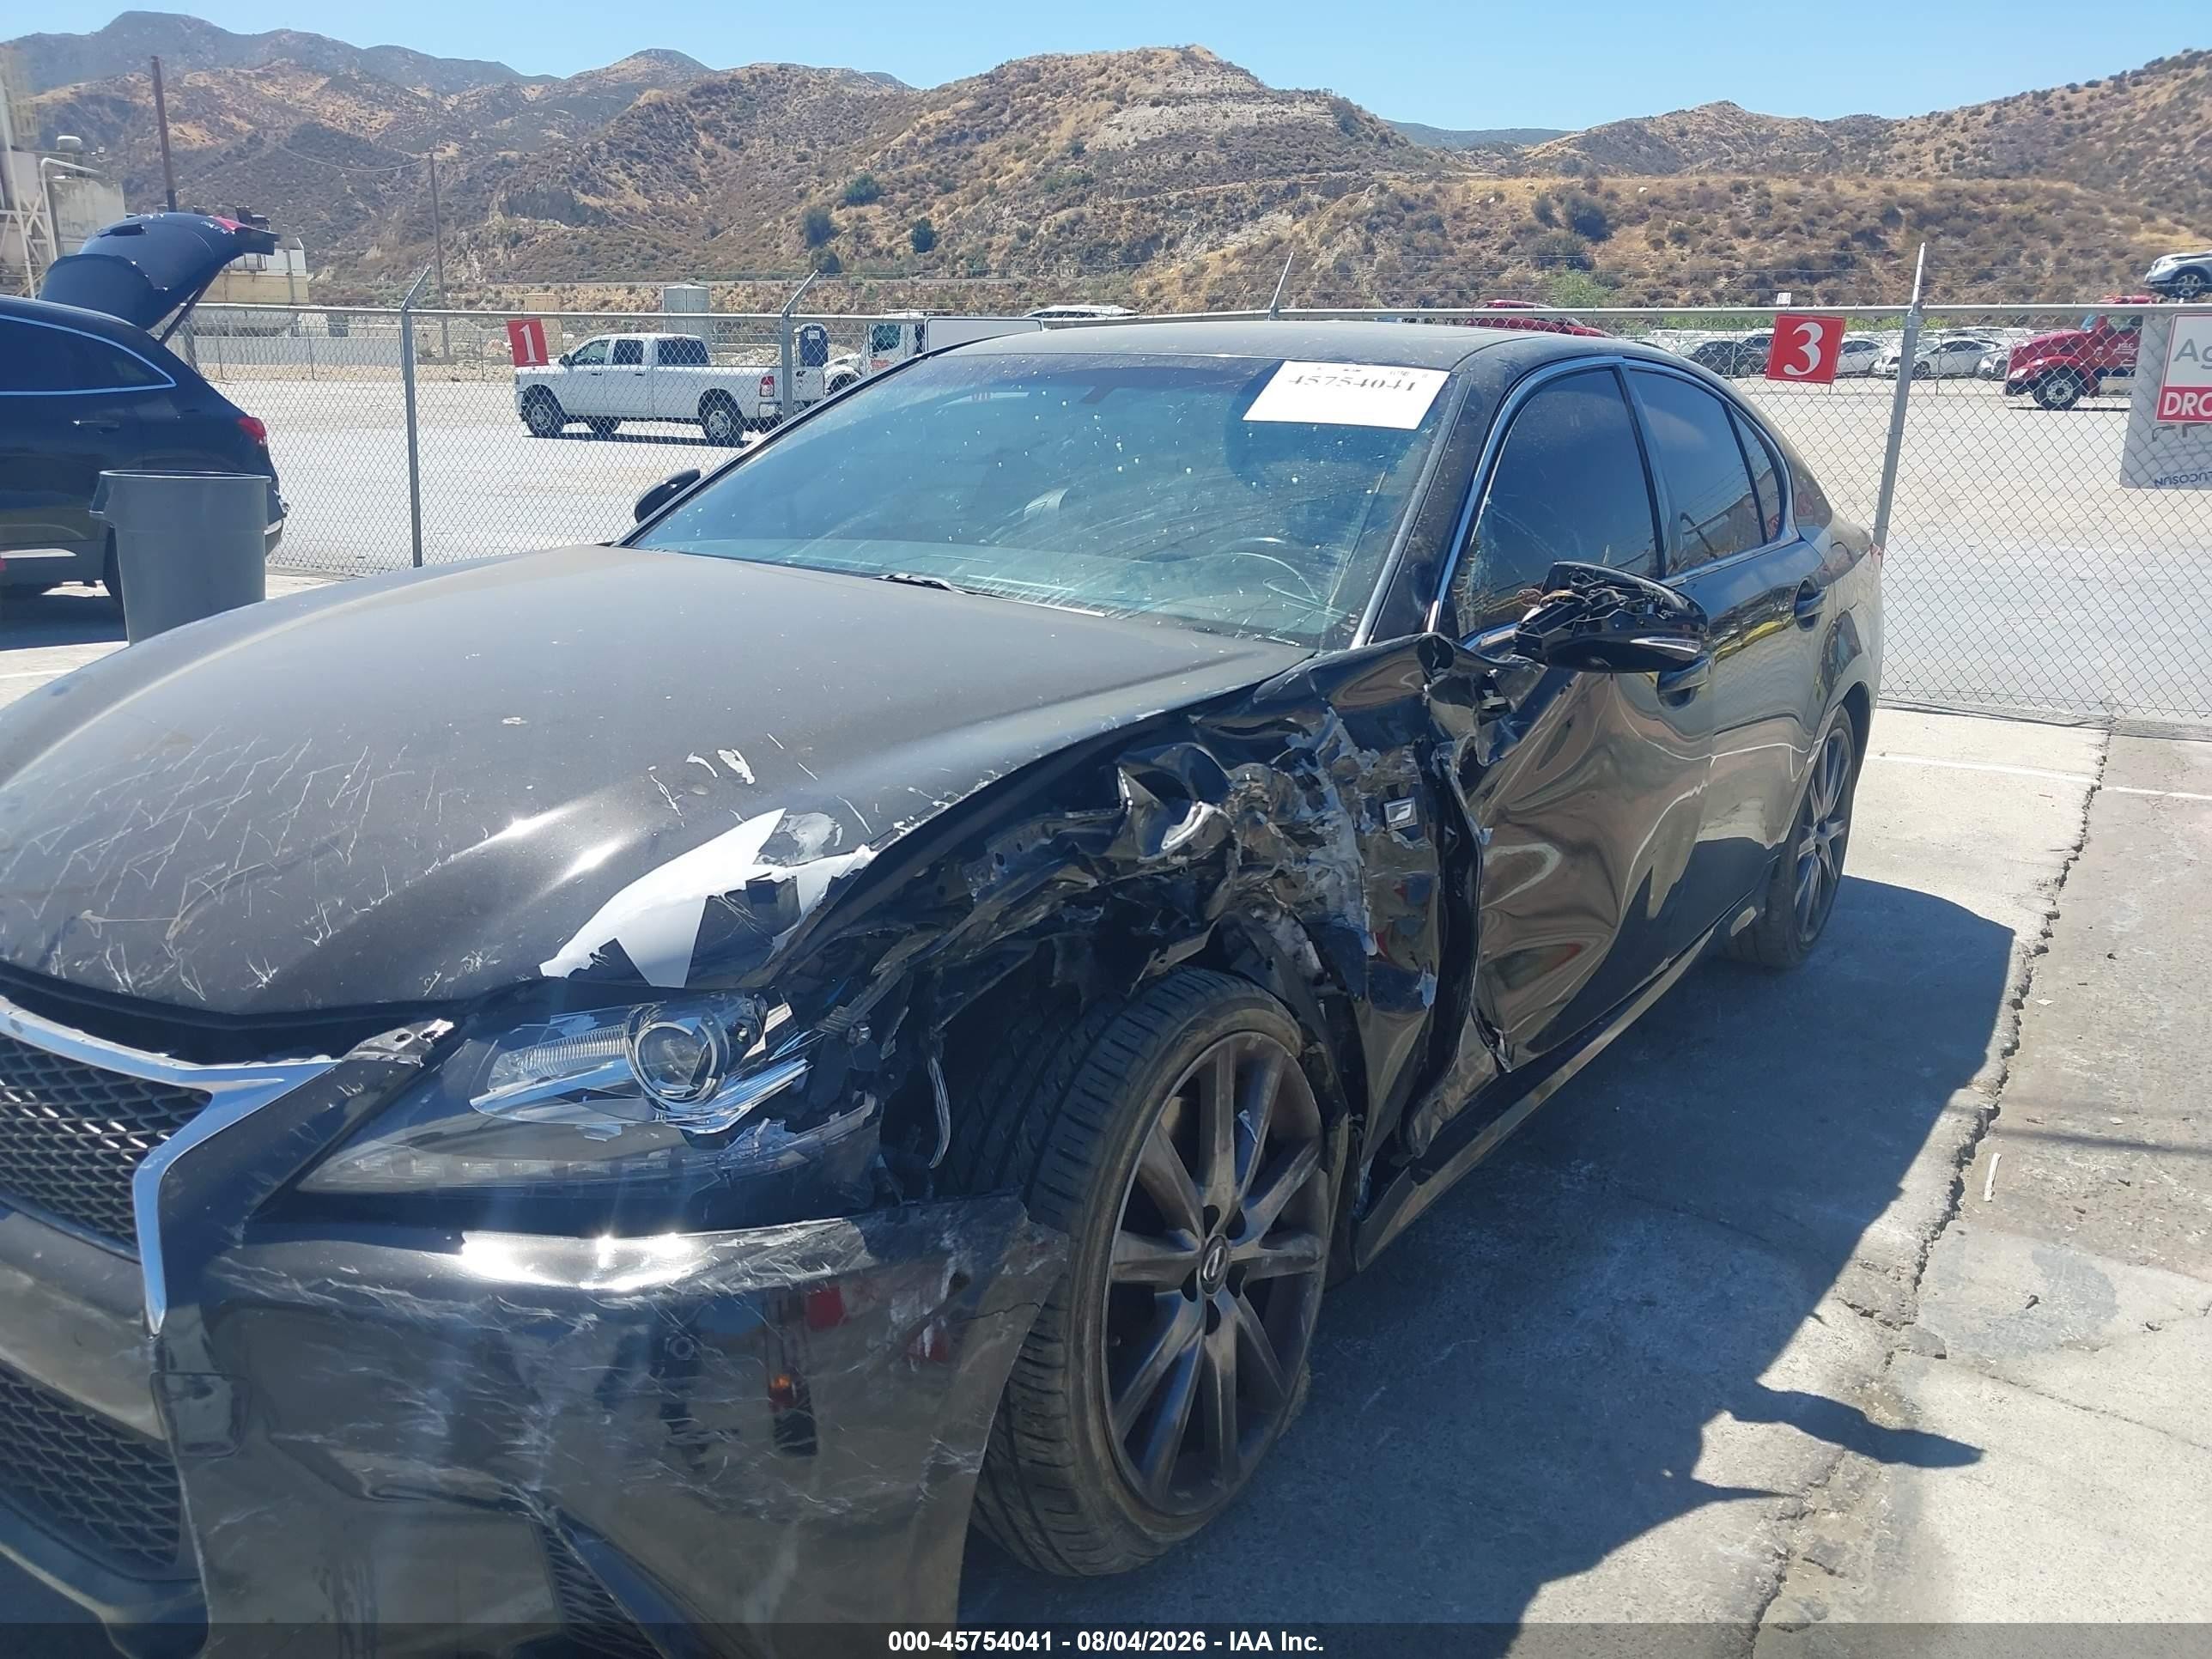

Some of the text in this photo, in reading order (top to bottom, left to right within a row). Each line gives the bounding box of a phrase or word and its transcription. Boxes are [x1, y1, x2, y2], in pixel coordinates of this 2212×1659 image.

[519, 324, 540, 362] 1
[1784, 322, 1823, 376] 3
[1288, 374, 1416, 392] 45754041
